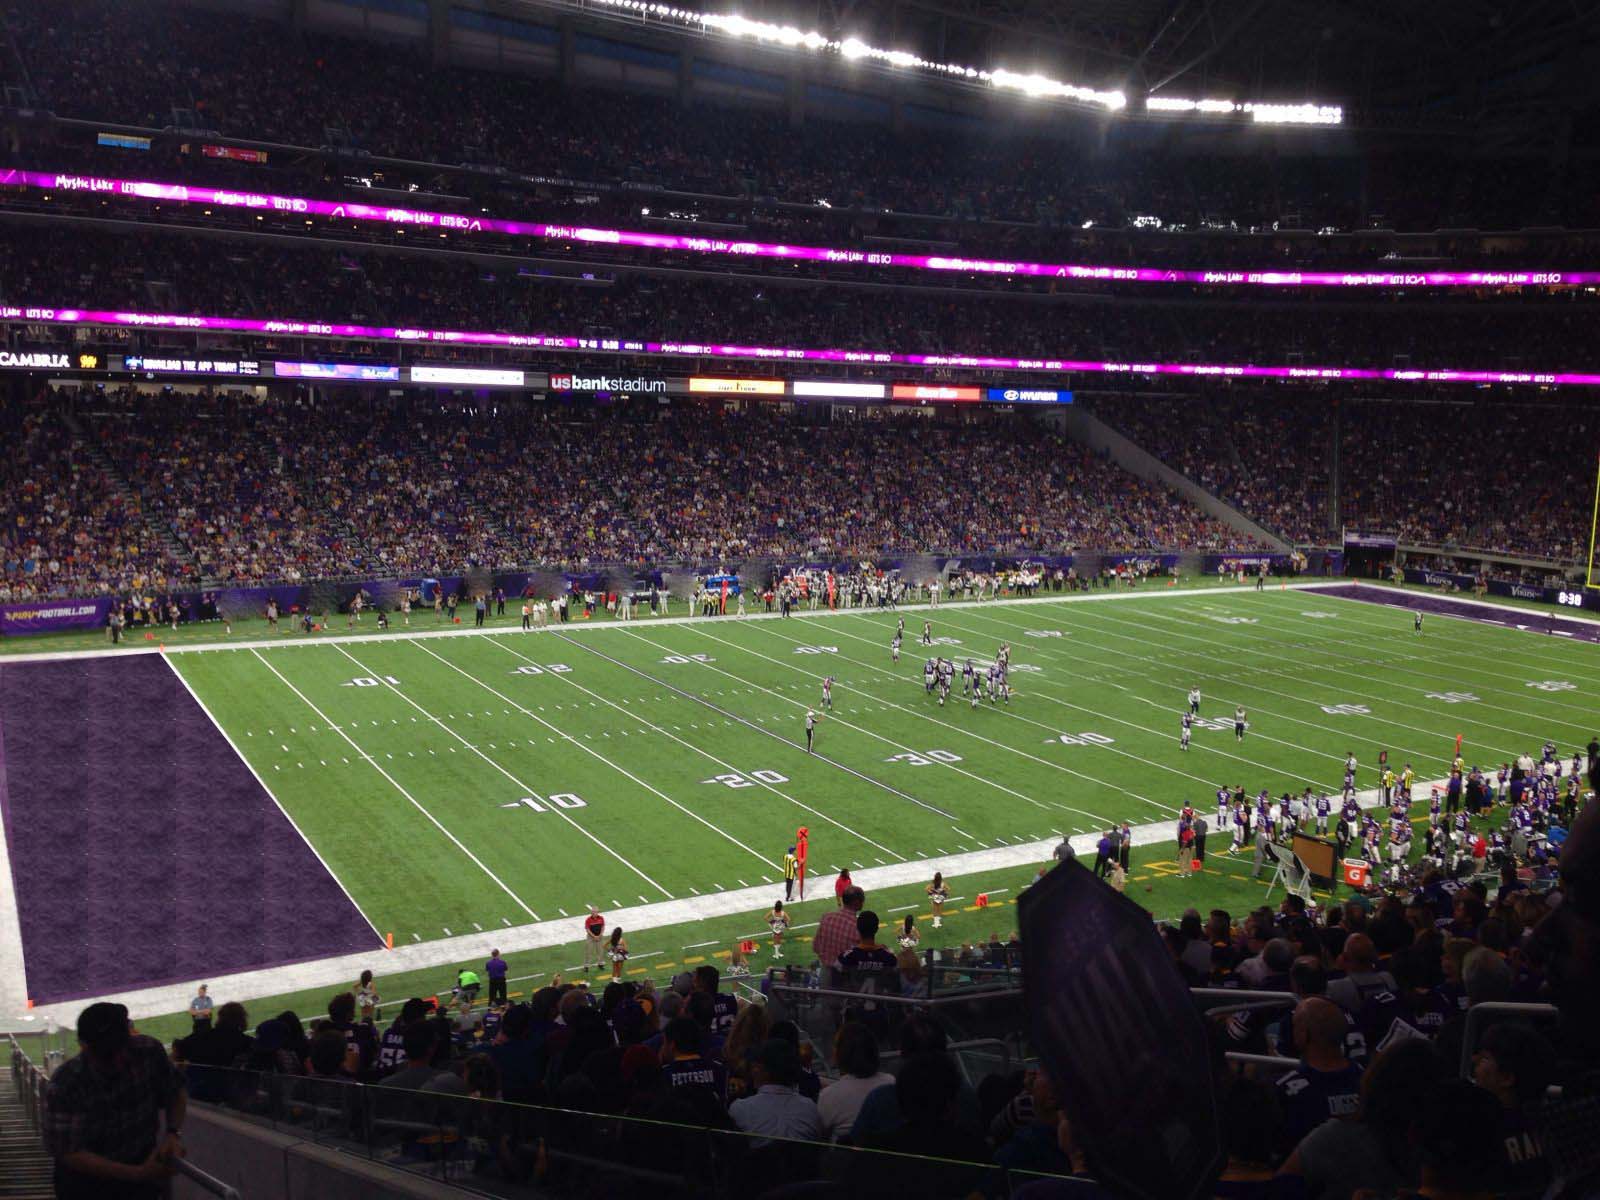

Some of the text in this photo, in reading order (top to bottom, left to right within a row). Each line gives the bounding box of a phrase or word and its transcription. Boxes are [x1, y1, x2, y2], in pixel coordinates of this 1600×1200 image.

[0, 352, 70, 367] CAMBRIA
[715, 770, 789, 788] 20
[519, 793, 588, 812] 10
[1349, 869, 1361, 881] G
